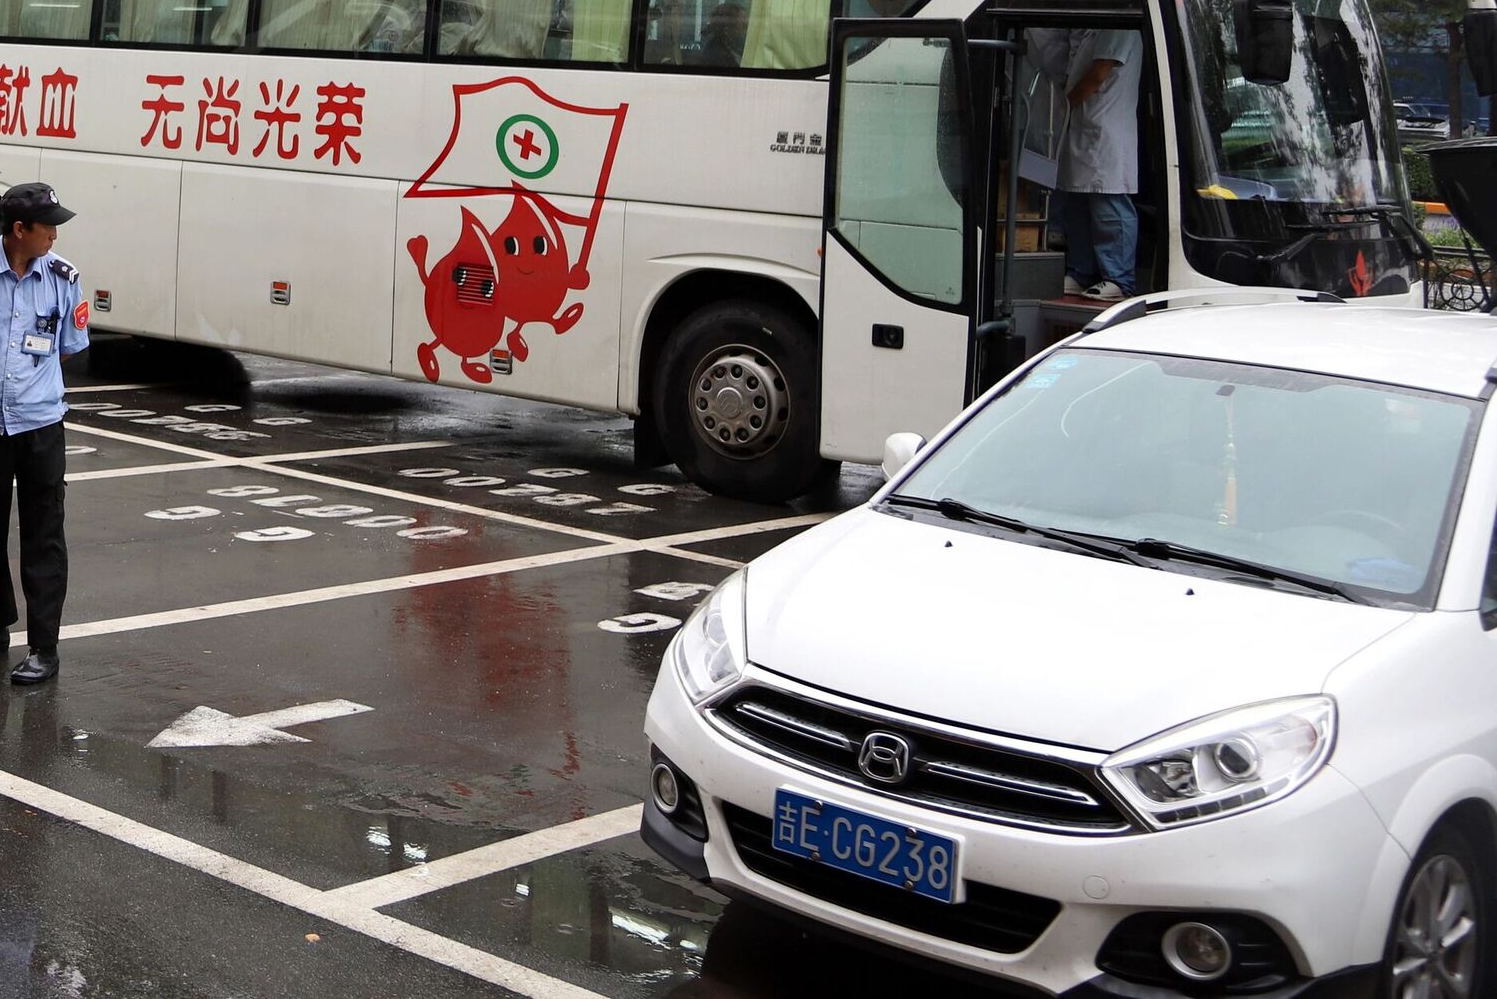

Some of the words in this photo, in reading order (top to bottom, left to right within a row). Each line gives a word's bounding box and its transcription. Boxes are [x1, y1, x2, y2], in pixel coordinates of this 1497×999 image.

[139, 74, 368, 167] 无尚光荣
[770, 144, 804, 153] GOLDEN
